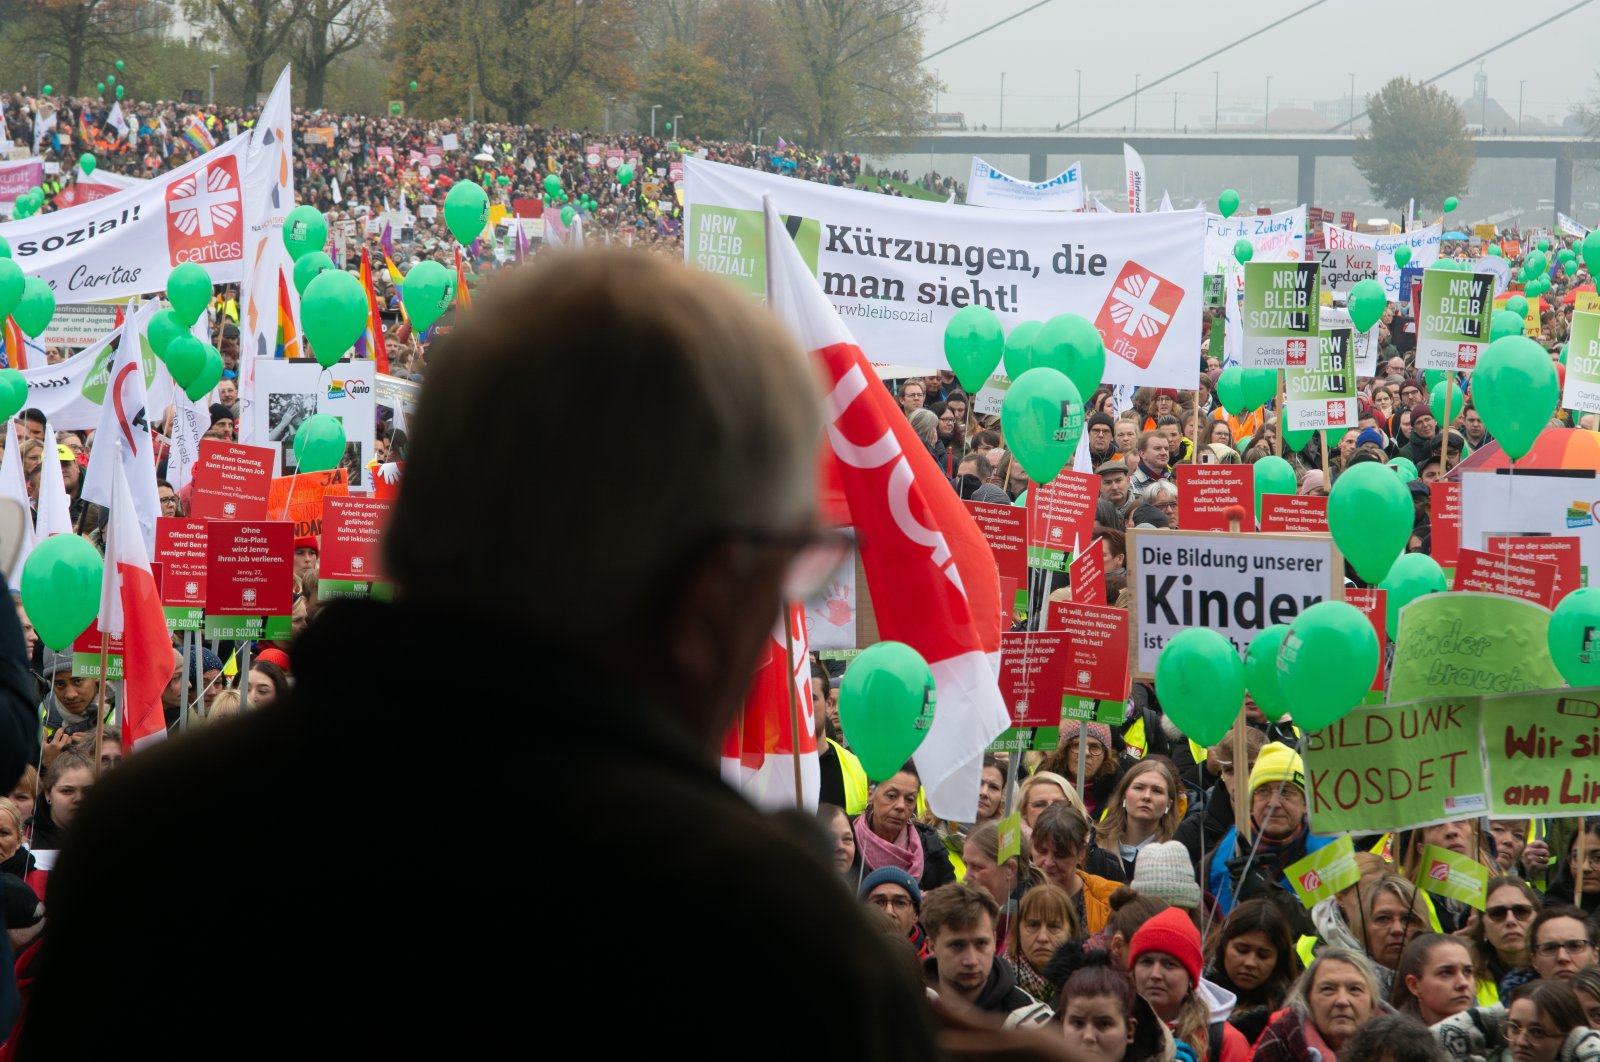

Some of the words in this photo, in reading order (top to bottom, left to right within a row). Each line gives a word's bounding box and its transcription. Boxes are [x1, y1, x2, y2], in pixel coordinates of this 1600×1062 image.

[700, 213, 737, 234] NRW
[1236, 220, 1248, 236] die
[1254, 216, 1293, 235] Zukunft
[17, 205, 141, 257] sozial!
[698, 232, 743, 256] BLEIB
[175, 240, 242, 265] caritas
[825, 224, 1040, 279] Kürzungen,
[1052, 243, 1108, 276] die
[1317, 251, 1336, 268] Zu
[1346, 254, 1372, 269] Kurz
[697, 253, 755, 278] SOZIAL!
[68, 264, 142, 291] Caritas
[1272, 270, 1308, 289] NRW
[822, 271, 906, 302] man
[917, 276, 1018, 313] sieht!
[1449, 279, 1483, 298] NRW
[1264, 290, 1307, 309] BLEIB
[1440, 297, 1480, 317] BLEIB
[1250, 310, 1306, 329] SOZIAL!
[1426, 314, 1479, 335] SOZIAL!
[1319, 336, 1341, 354] RW
[1257, 347, 1285, 355] Caritas
[1430, 349, 1456, 359] Caritas
[1254, 358, 1262, 366] in
[1263, 358, 1285, 366] NRW
[1435, 360, 1456, 368] NRW
[1292, 375, 1343, 393] SOZIAL!
[352, 386, 370, 394] AWO
[1300, 409, 1325, 417] Caritas
[1306, 419, 1326, 427] NRW
[229, 447, 246, 456] Ohne
[211, 453, 236, 463] Offenen
[237, 457, 261, 467] Ganztag
[205, 461, 221, 469] kann
[222, 463, 236, 471] Lena
[222, 472, 246, 481] knicken.
[320, 469, 342, 486] JA
[1057, 473, 1087, 484] Menschen
[1225, 479, 1243, 487] spart,
[1200, 487, 1230, 495] gefährdet
[1193, 496, 1214, 504] Kultur,
[997, 508, 1011, 516] das?
[1300, 508, 1325, 517] Ganztag
[977, 515, 1019, 526] Drogenkonsum
[337, 526, 357, 534] Kultur,
[359, 527, 381, 535] Vielfalt
[1006, 535, 1024, 543] Hilfen
[248, 546, 270, 555] Jenny
[990, 543, 1018, 551] abgebaut.
[1525, 542, 1539, 550] der
[1540, 542, 1571, 550] sozialen
[160, 550, 186, 558] weniger
[237, 555, 250, 563] Job
[251, 555, 284, 563] verlieren.
[1050, 552, 1065, 560] NRW
[1536, 553, 1558, 561] spart,
[1040, 558, 1065, 569] SOZIAL!
[1142, 547, 1172, 566] Die
[1177, 548, 1248, 573] Bildung
[1253, 555, 1323, 572] unserer
[1476, 557, 1493, 567] Wer
[1472, 569, 1489, 577] aufs
[353, 584, 368, 592] NRW
[1524, 588, 1541, 599] den
[188, 610, 203, 619] NRW
[1069, 609, 1083, 617] will,
[1084, 610, 1099, 618] dass
[1100, 613, 1122, 621] meine
[178, 619, 203, 628] SOZIAL!
[246, 619, 263, 628] NRW
[1061, 616, 1095, 627] Erzieherin
[1095, 621, 1117, 630] Nicole
[213, 628, 235, 637] BLEIB
[235, 628, 263, 637] SOZIAL!
[1086, 629, 1099, 638] Zeit
[1100, 631, 1111, 639] für
[1009, 638, 1024, 646] will,
[1071, 637, 1088, 646] mich
[1089, 638, 1103, 647] hat!
[1144, 633, 1164, 649] ist
[1001, 647, 1034, 655] Erzieherin
[1004, 658, 1026, 666] genug
[80, 665, 100, 674] BLEIB
[1028, 666, 1042, 674] hat!
[1078, 700, 1095, 710] NRW
[1068, 709, 1095, 720] SOZIAL!
[1307, 704, 1466, 751] BILDUNK
[1016, 730, 1032, 739] NRW
[1005, 739, 1032, 750] SOZIAL!
[1504, 723, 1563, 760] Wir
[1310, 750, 1468, 814] KOSDET
[1504, 784, 1550, 806] am
